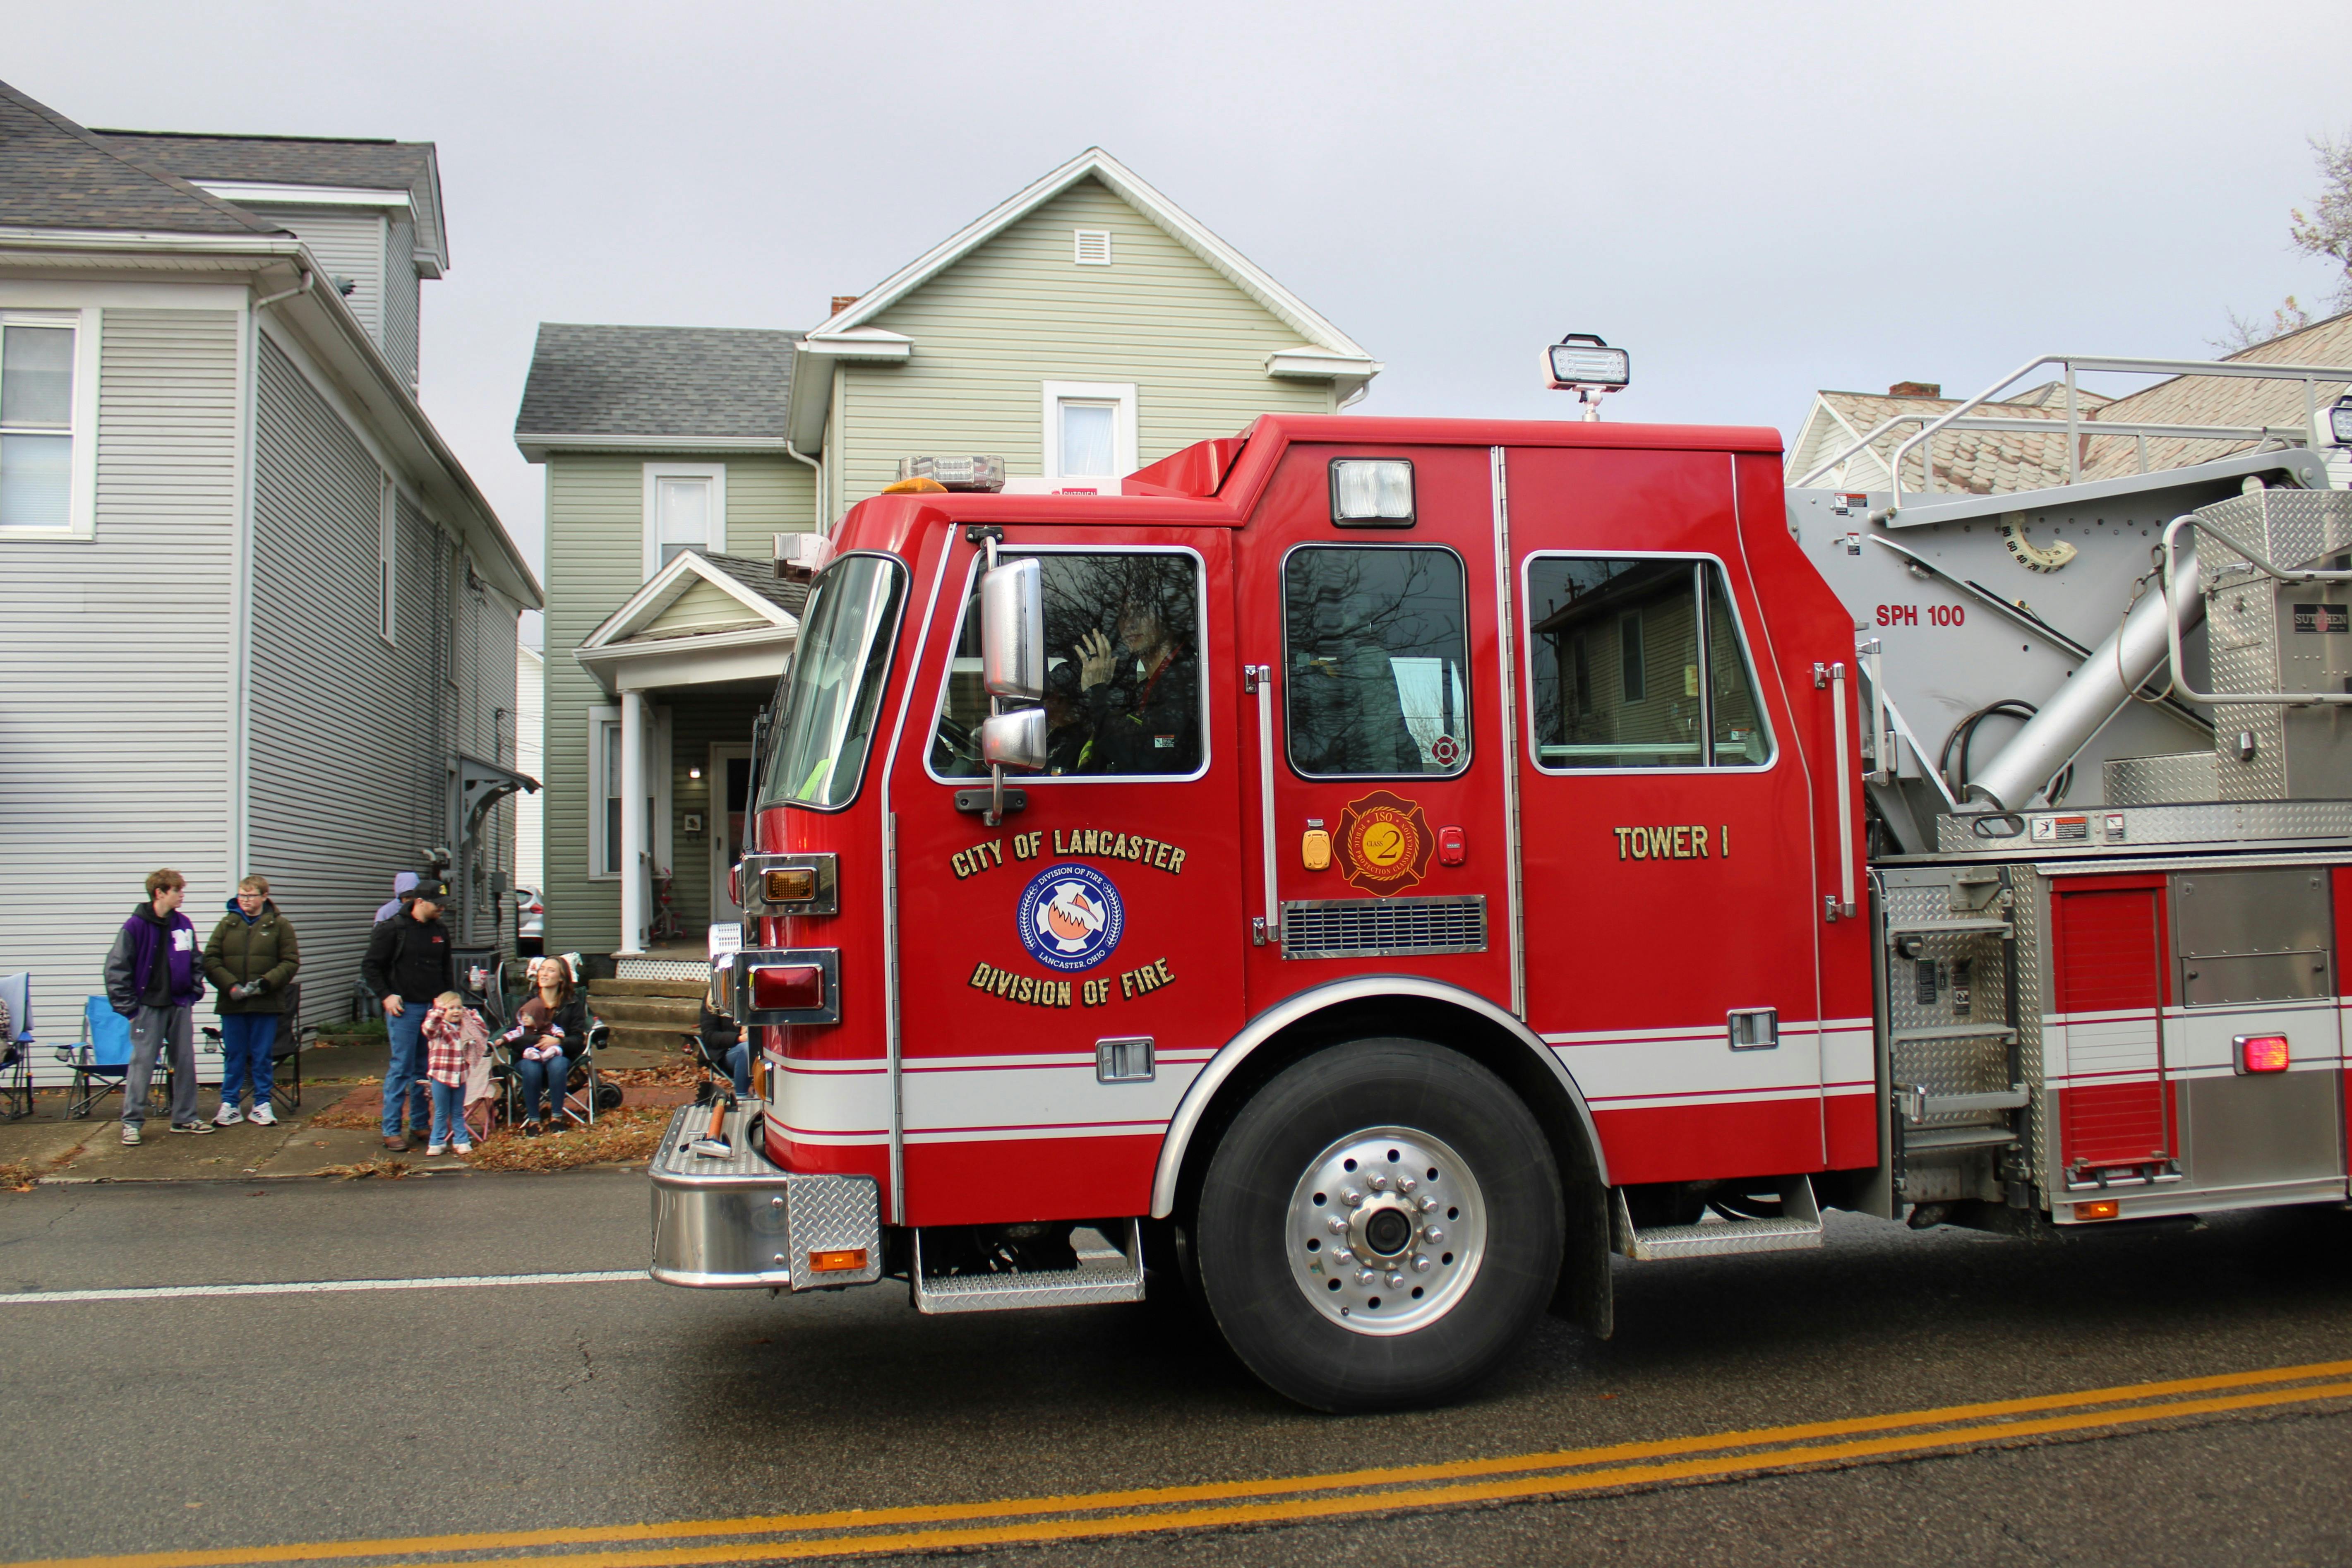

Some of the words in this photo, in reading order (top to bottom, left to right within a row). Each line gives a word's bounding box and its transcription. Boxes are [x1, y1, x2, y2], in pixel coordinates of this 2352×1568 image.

[2002, 526, 2011, 537] 80
[2006, 541, 2018, 552] 60
[2016, 555, 2028, 564] 40
[2028, 563, 2040, 571] 20
[1877, 605, 1918, 627] SPH
[1927, 605, 1965, 627] 100
[2295, 614, 2347, 624] SUTPHEN
[1375, 812, 1393, 822] ISO
[1354, 824, 1366, 848] PUBLIC
[1377, 830, 1400, 859] 2
[1614, 826, 1709, 860] TOWER
[951, 838, 1003, 879] CITY
[1013, 831, 1043, 860] OF
[1054, 829, 1186, 874] LANCASTER
[1393, 824, 1413, 872] CLASSIFICATION
[1356, 850, 1391, 874] PROTECTION
[1037, 867, 1073, 885] DIVISION
[1085, 870, 1103, 884] FIRE
[1038, 952, 1086, 969] LANCASTER,
[1086, 950, 1106, 965] OHIO
[970, 961, 1071, 1006] DIVISION
[1082, 978, 1111, 1006] OF
[1121, 957, 1176, 1000] FIRE
